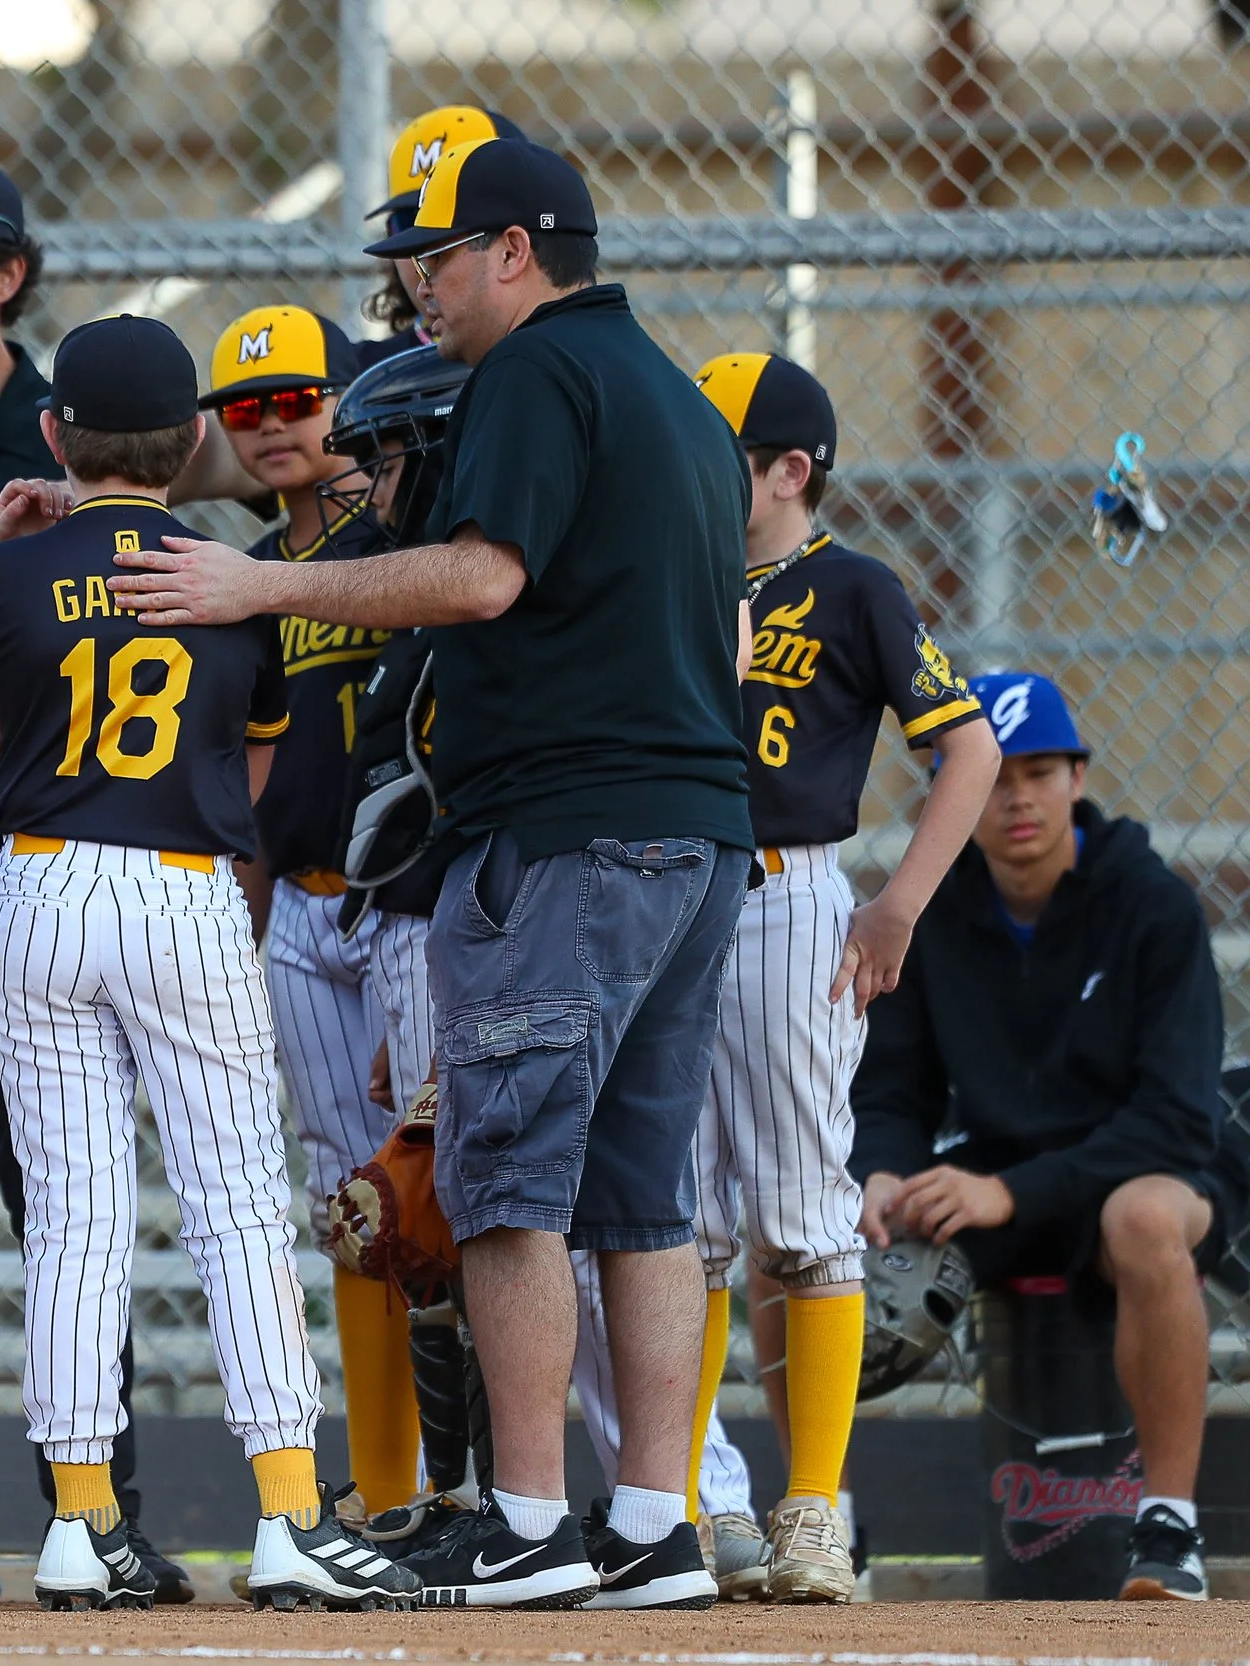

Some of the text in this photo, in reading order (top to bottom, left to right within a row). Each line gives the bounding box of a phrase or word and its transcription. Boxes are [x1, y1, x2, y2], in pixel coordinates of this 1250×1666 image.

[409, 138, 442, 177] M
[238, 328, 270, 364] M
[56, 637, 193, 780] 18
[337, 682, 366, 754] 1
[757, 705, 796, 768] 6
